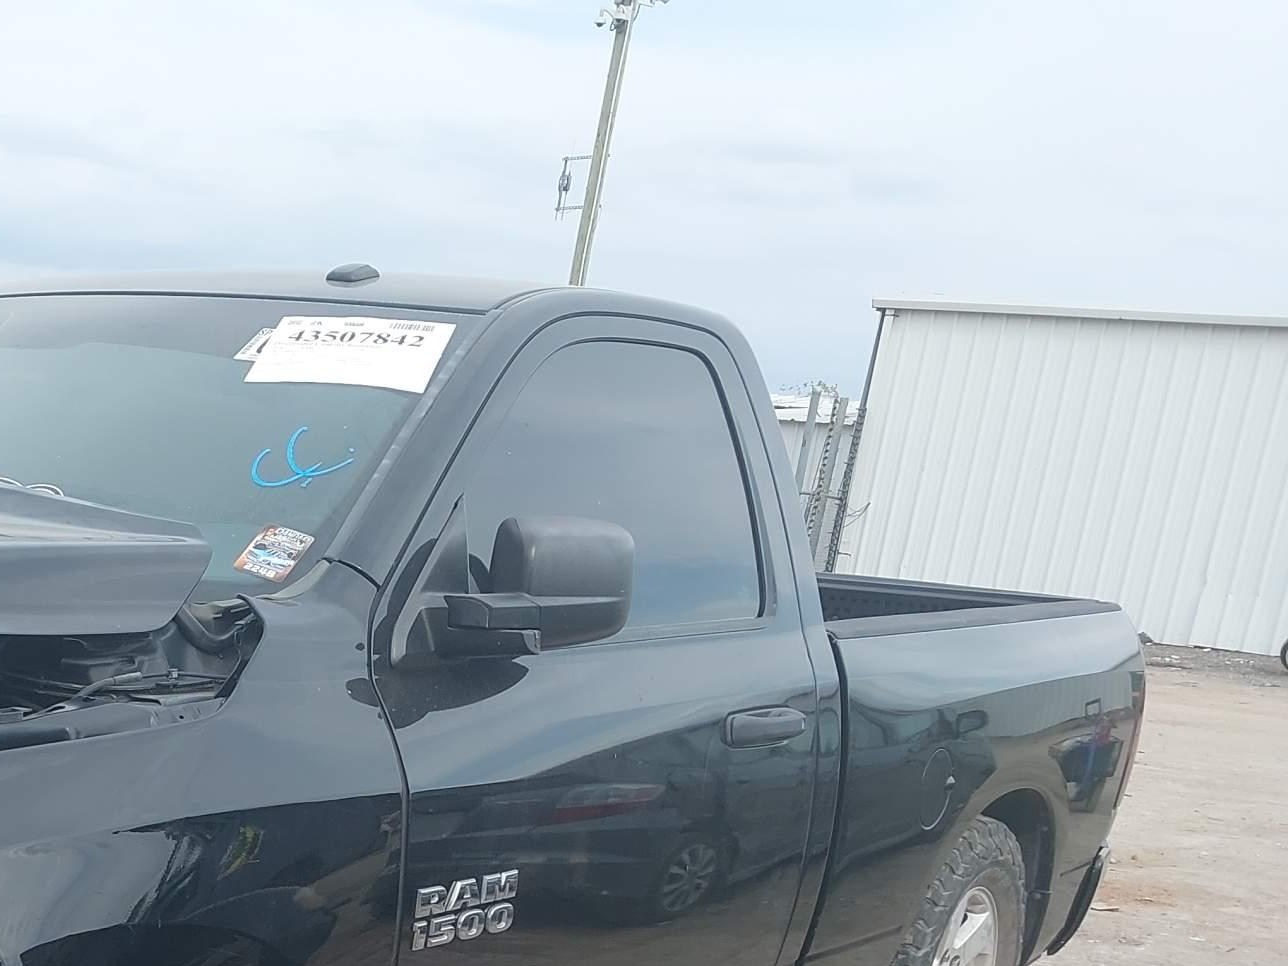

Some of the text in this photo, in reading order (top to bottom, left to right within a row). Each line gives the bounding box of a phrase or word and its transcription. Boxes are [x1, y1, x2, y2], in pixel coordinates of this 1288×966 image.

[287, 329, 425, 348] 43507842
[414, 868, 519, 919] RAM
[411, 901, 515, 952] 1500
